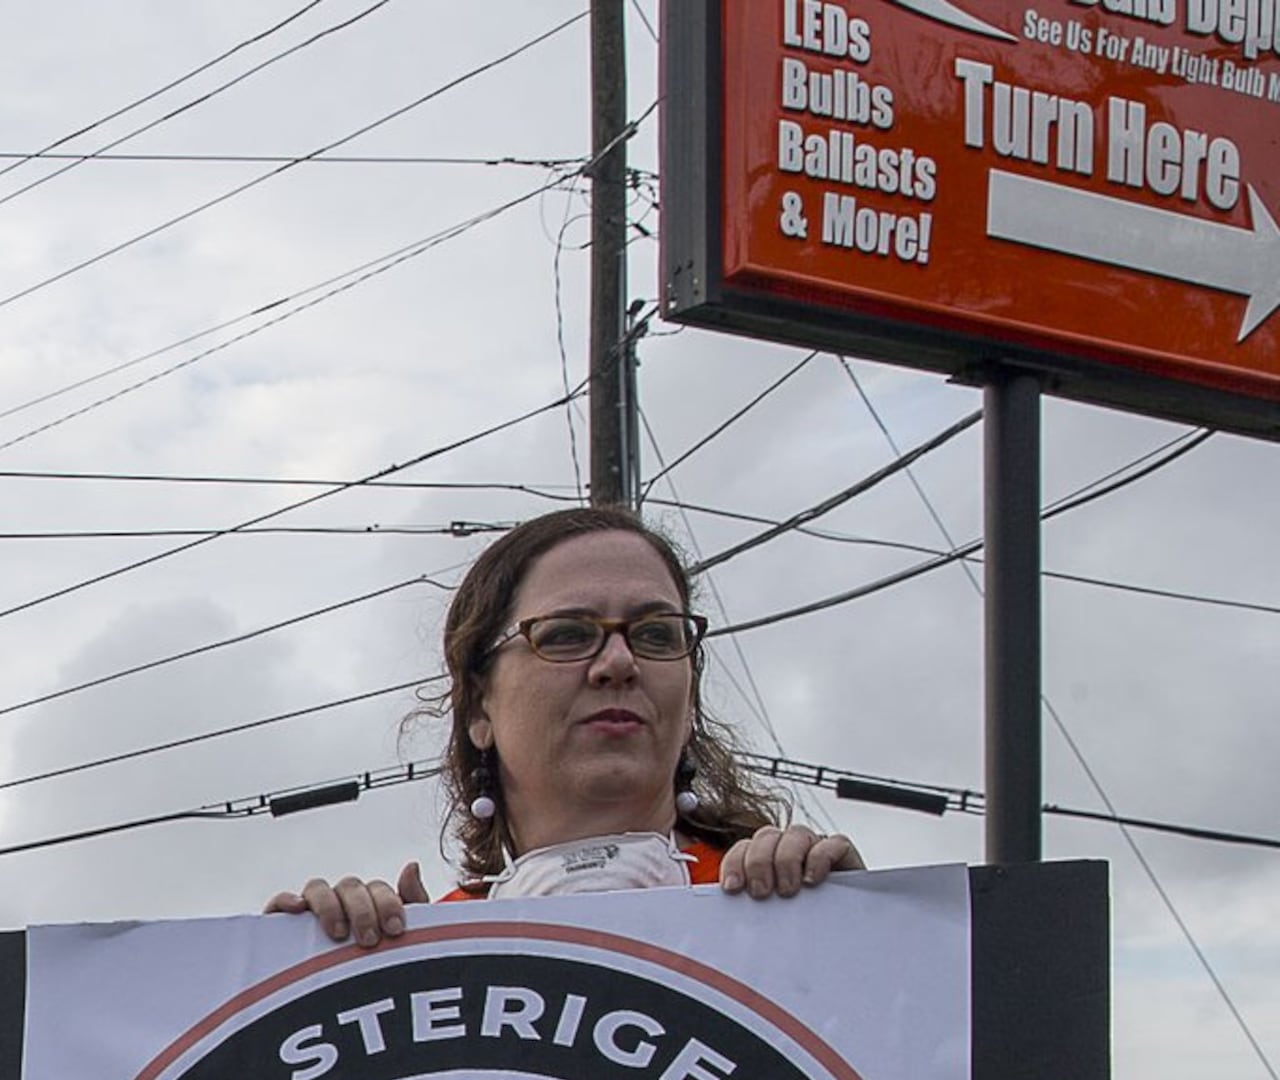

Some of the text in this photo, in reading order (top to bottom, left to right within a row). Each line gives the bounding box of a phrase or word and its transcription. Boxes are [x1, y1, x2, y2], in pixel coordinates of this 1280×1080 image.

[783, 0, 871, 63] LEDs
[1023, 8, 1062, 46] See
[1066, 19, 1092, 54] Us
[1096, 28, 1130, 62] For
[1131, 37, 1170, 75] Any
[1171, 45, 1219, 86] Light
[1221, 61, 1265, 99] Bulb
[781, 56, 895, 129] Bulbs
[777, 118, 938, 201] Ballasts
[955, 57, 1241, 211] Turn Here
[779, 190, 933, 265] & More!
